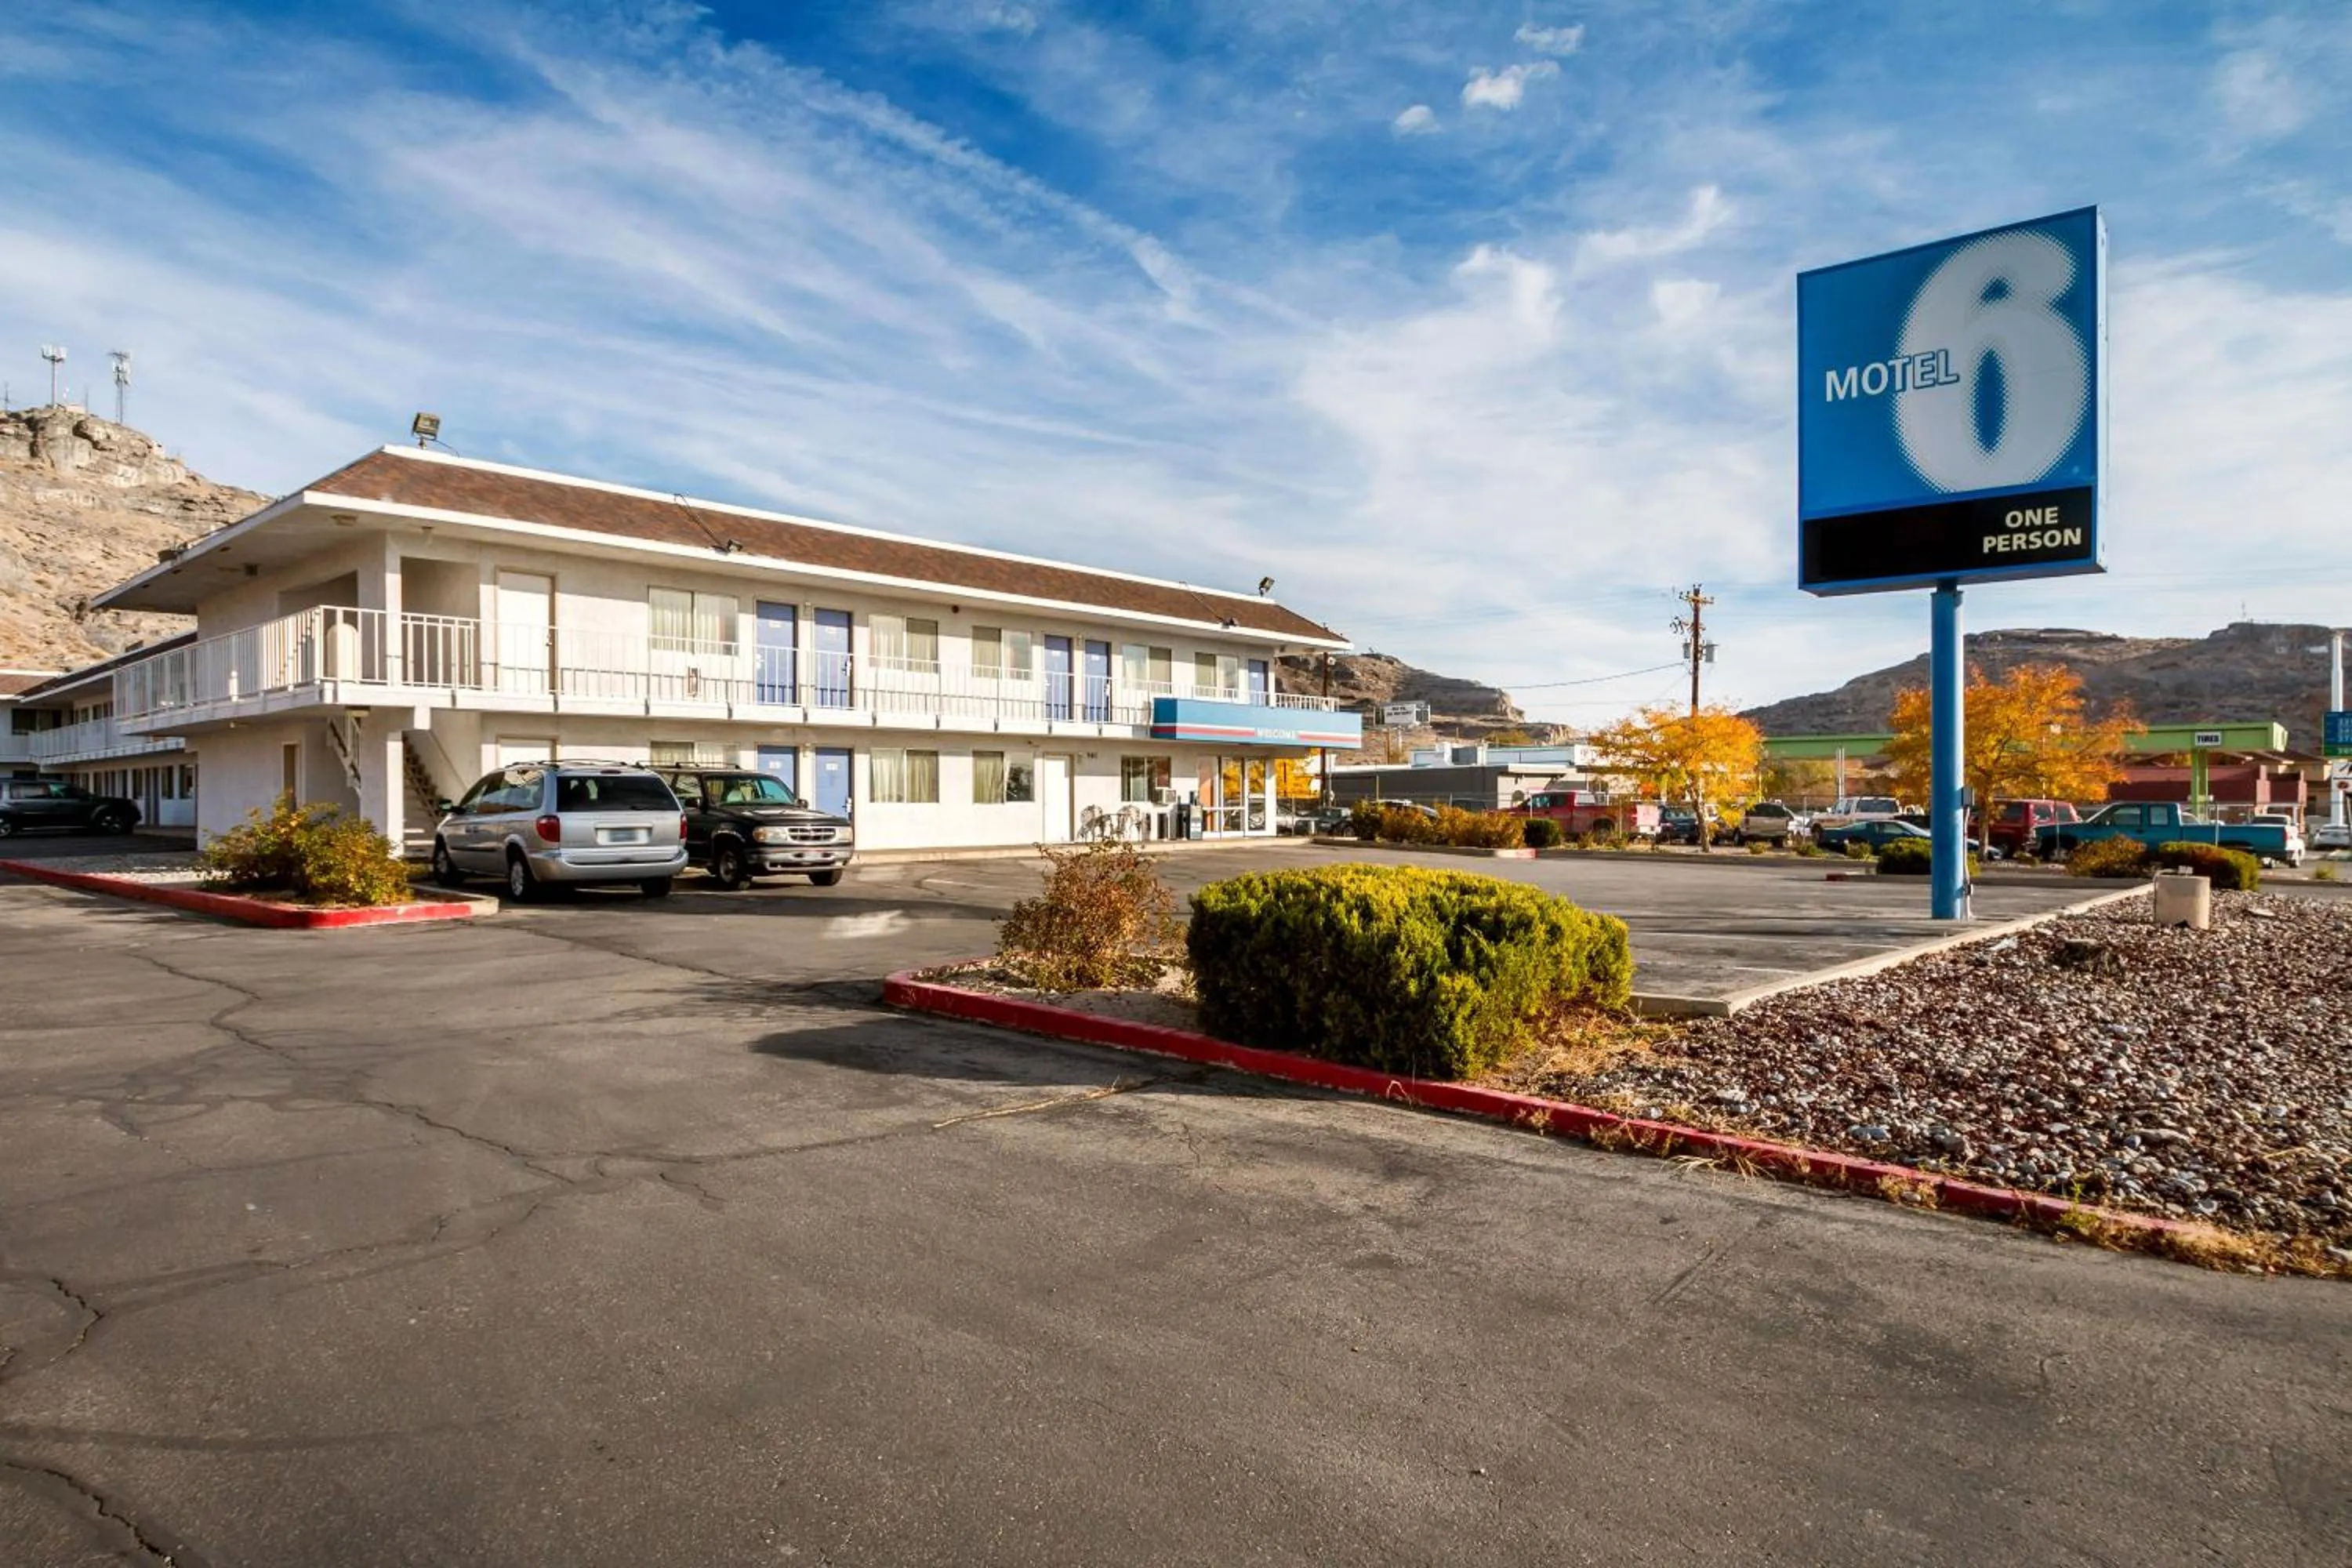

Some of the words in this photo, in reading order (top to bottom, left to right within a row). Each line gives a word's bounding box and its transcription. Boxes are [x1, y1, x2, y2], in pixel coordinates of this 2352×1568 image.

[1891, 229, 2091, 494] 6
[1825, 349, 1960, 402] MOTEL
[2005, 506, 2059, 528] ONE
[1982, 528, 2082, 554] PERSON
[2197, 734, 2220, 742] TIRES
